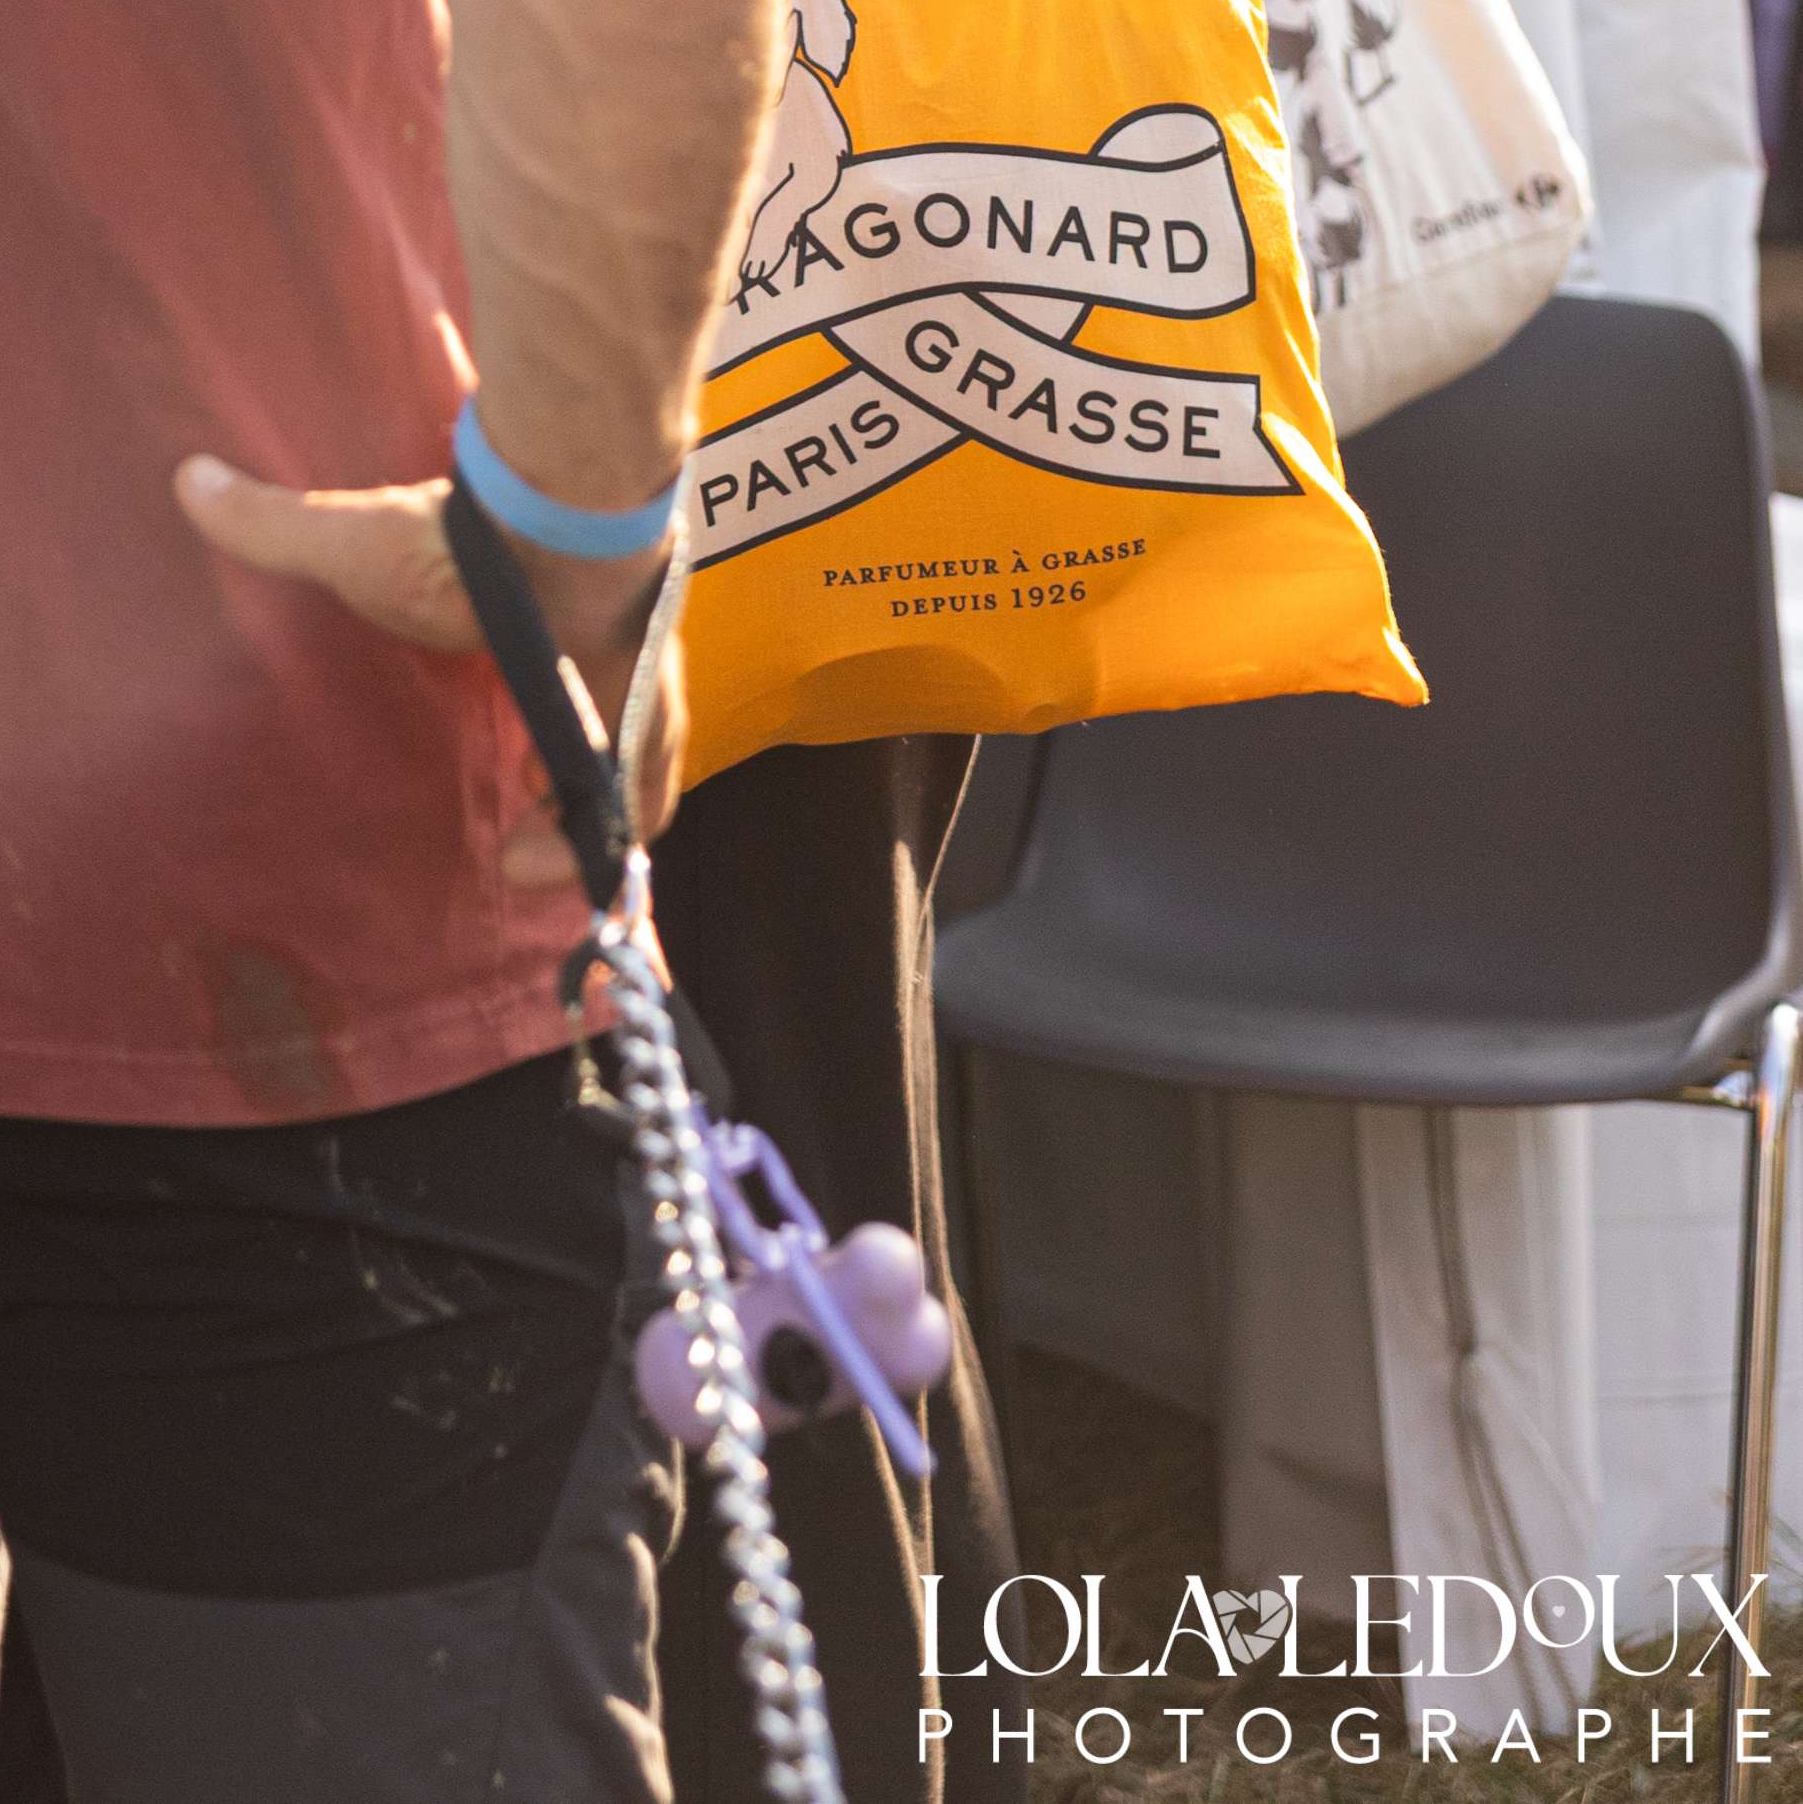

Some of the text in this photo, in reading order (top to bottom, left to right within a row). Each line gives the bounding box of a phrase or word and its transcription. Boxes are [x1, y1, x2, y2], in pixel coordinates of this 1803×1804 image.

[904, 320, 1221, 459] GRASSE
[699, 400, 900, 527] PARIS
[823, 538, 1147, 587] PARFUMEUR À GRASSE
[889, 580, 1087, 618] DEPUIS 1926
